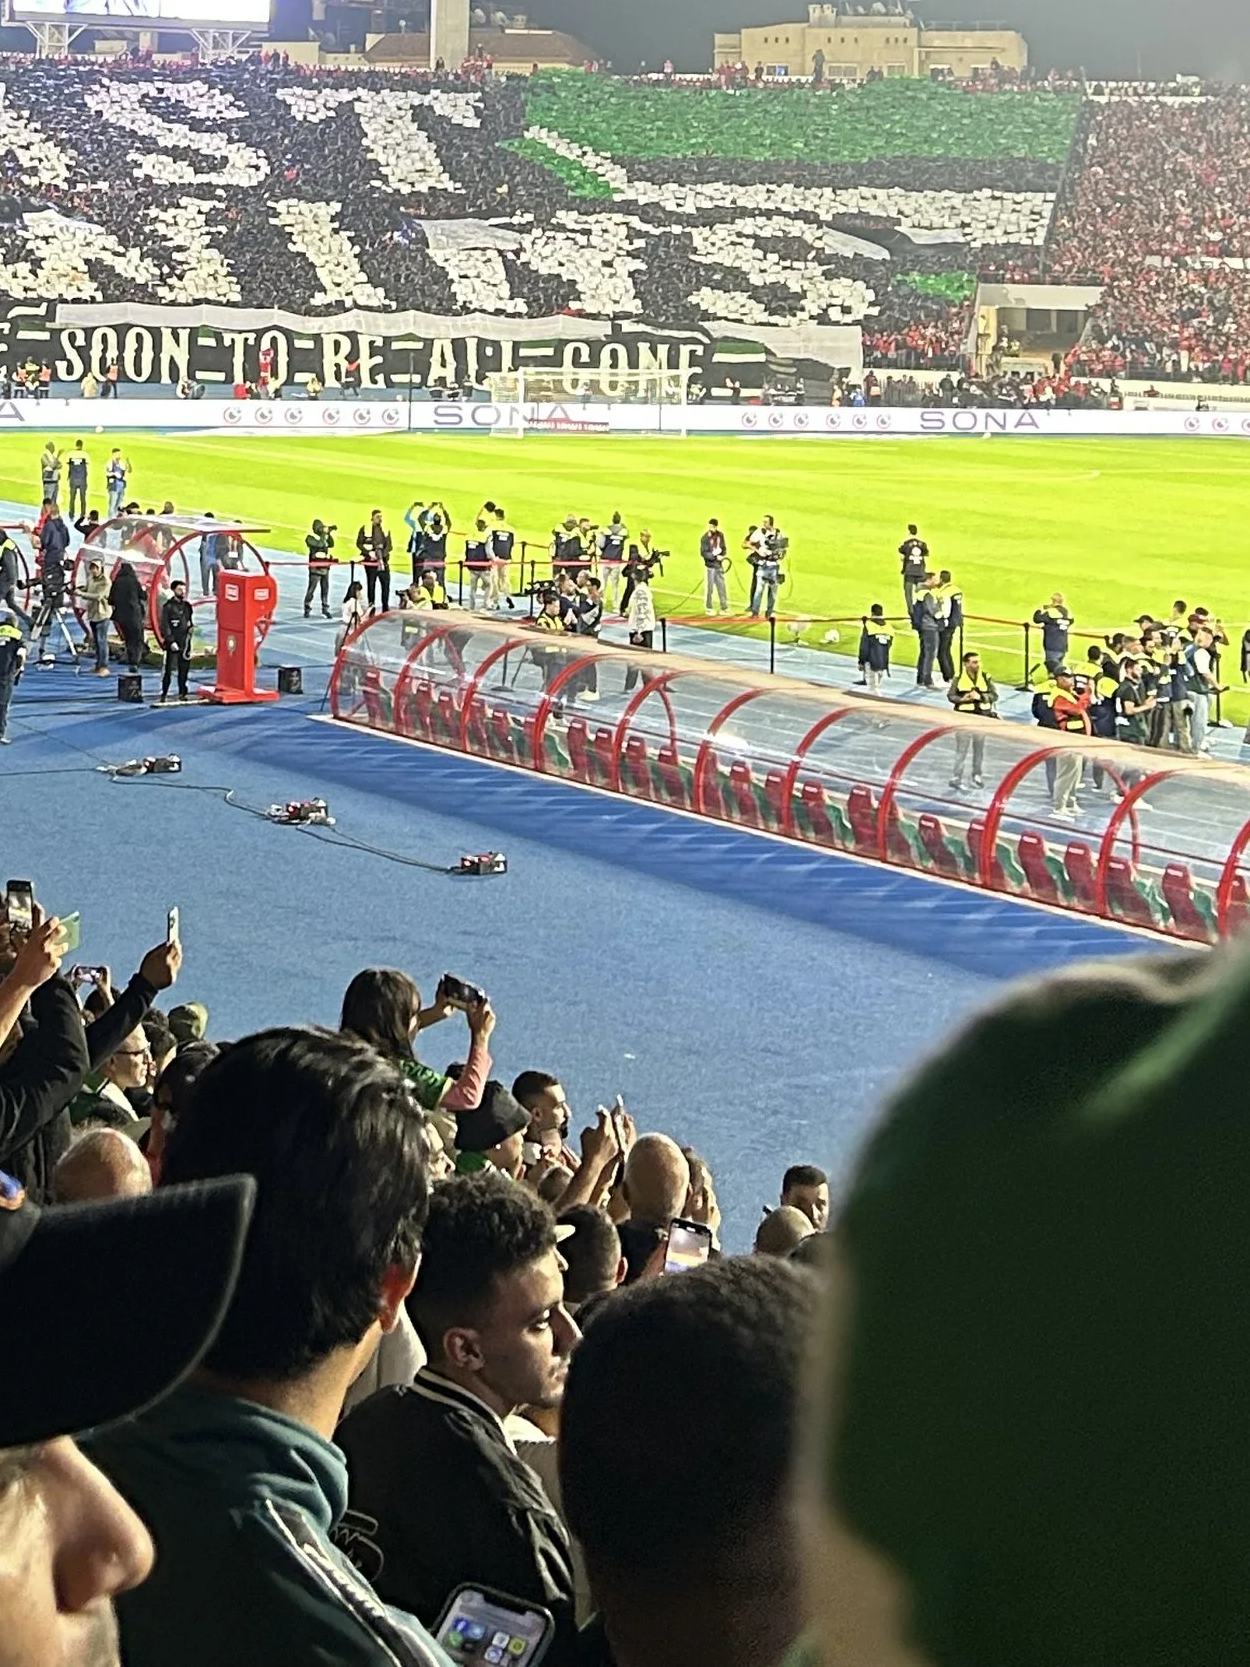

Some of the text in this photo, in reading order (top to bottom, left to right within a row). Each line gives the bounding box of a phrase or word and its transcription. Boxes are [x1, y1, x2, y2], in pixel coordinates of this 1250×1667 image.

[54, 326, 192, 385] SOON
[222, 330, 290, 385] TO
[321, 332, 387, 390] BE
[919, 408, 1040, 431] SONA
